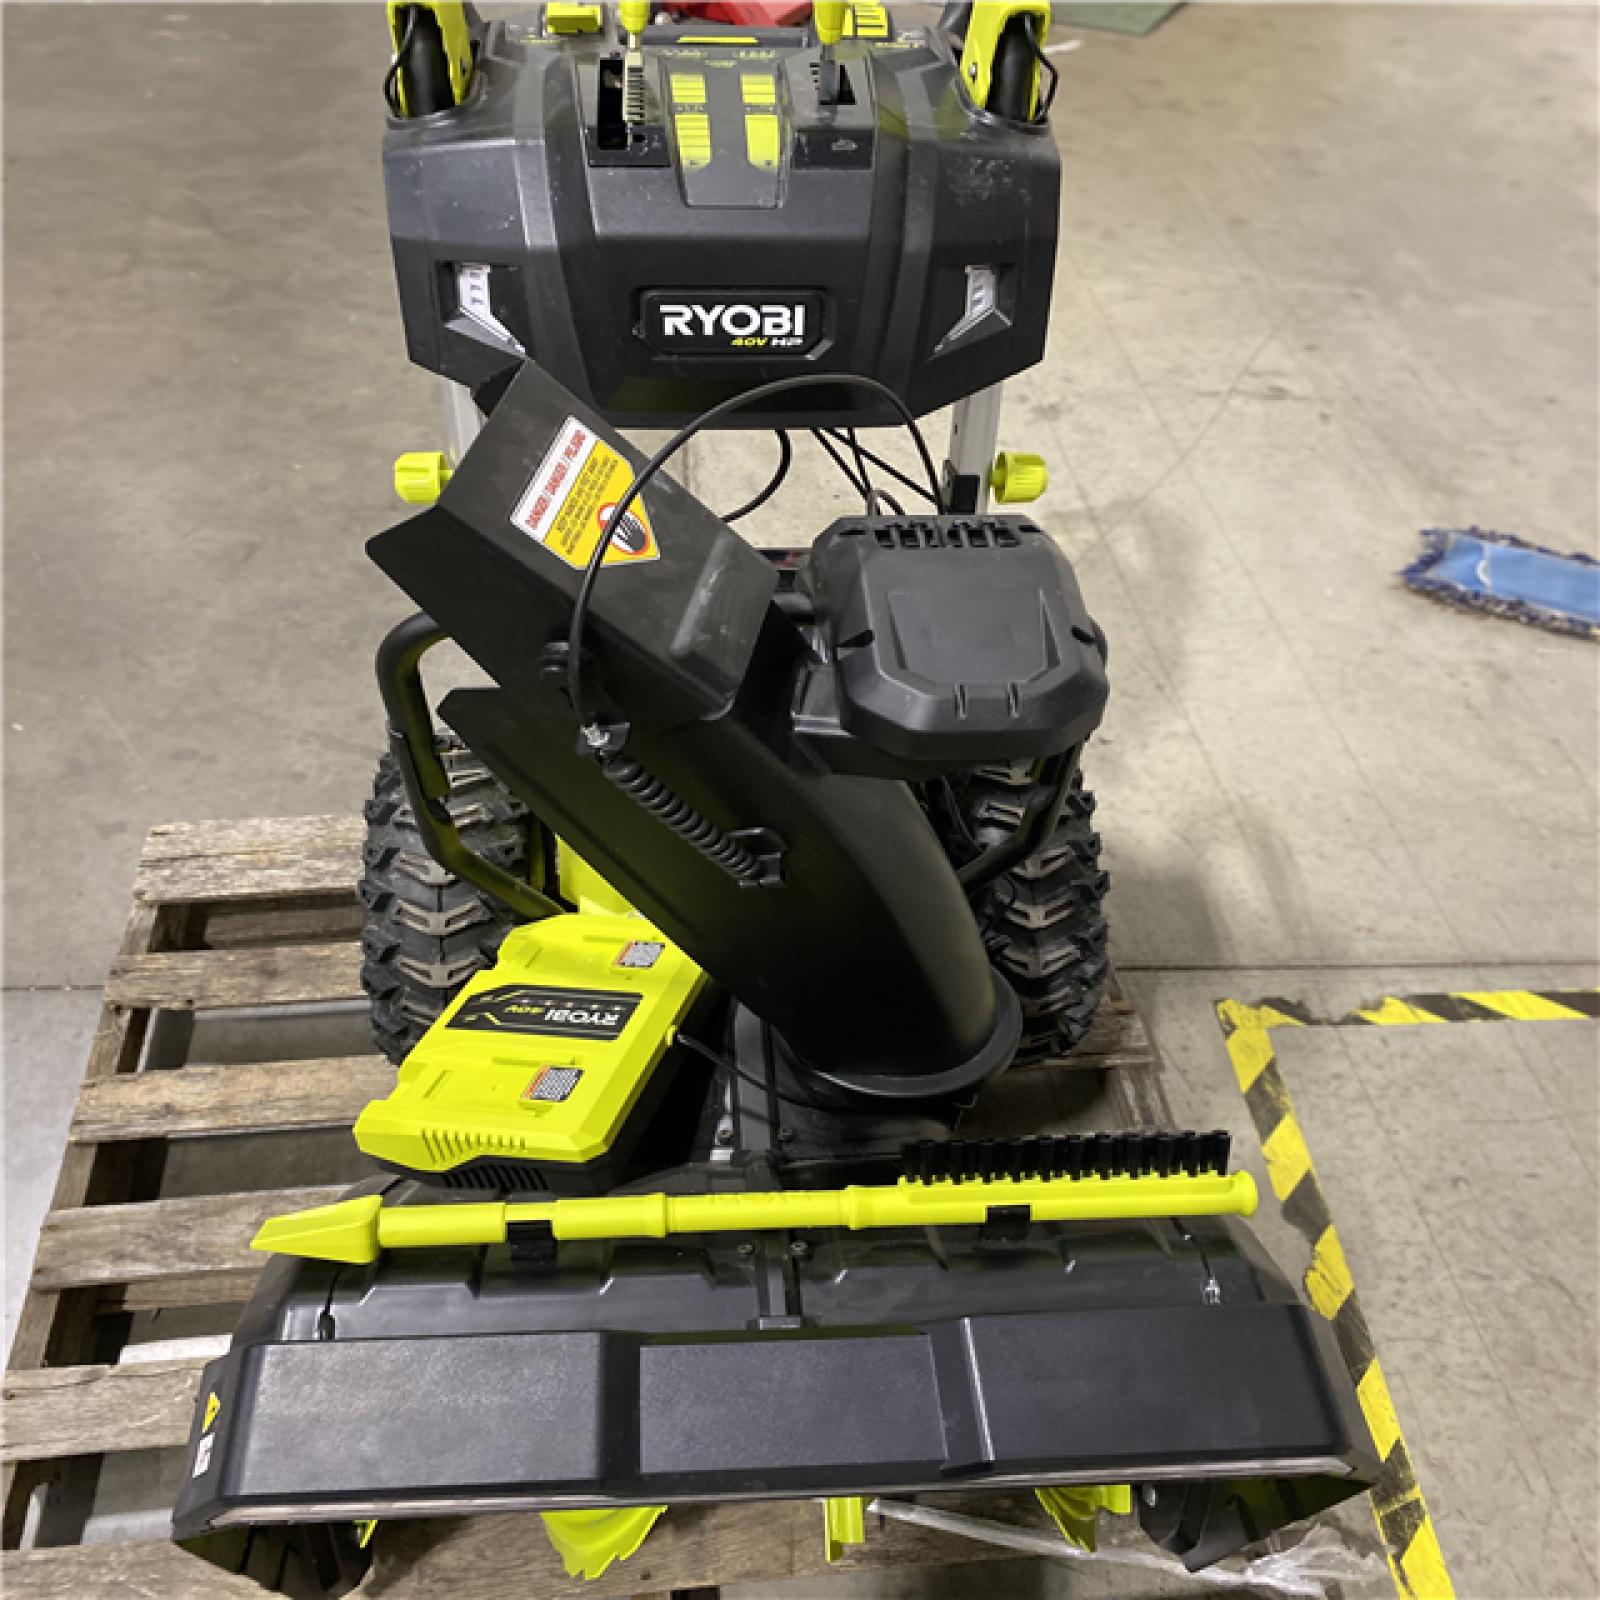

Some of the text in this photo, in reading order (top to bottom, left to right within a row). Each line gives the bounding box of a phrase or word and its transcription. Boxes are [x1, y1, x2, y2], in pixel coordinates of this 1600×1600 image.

[660, 304, 805, 336] RYOBI
[731, 337, 768, 346] 40V
[544, 1009, 620, 1026] RYOBI
